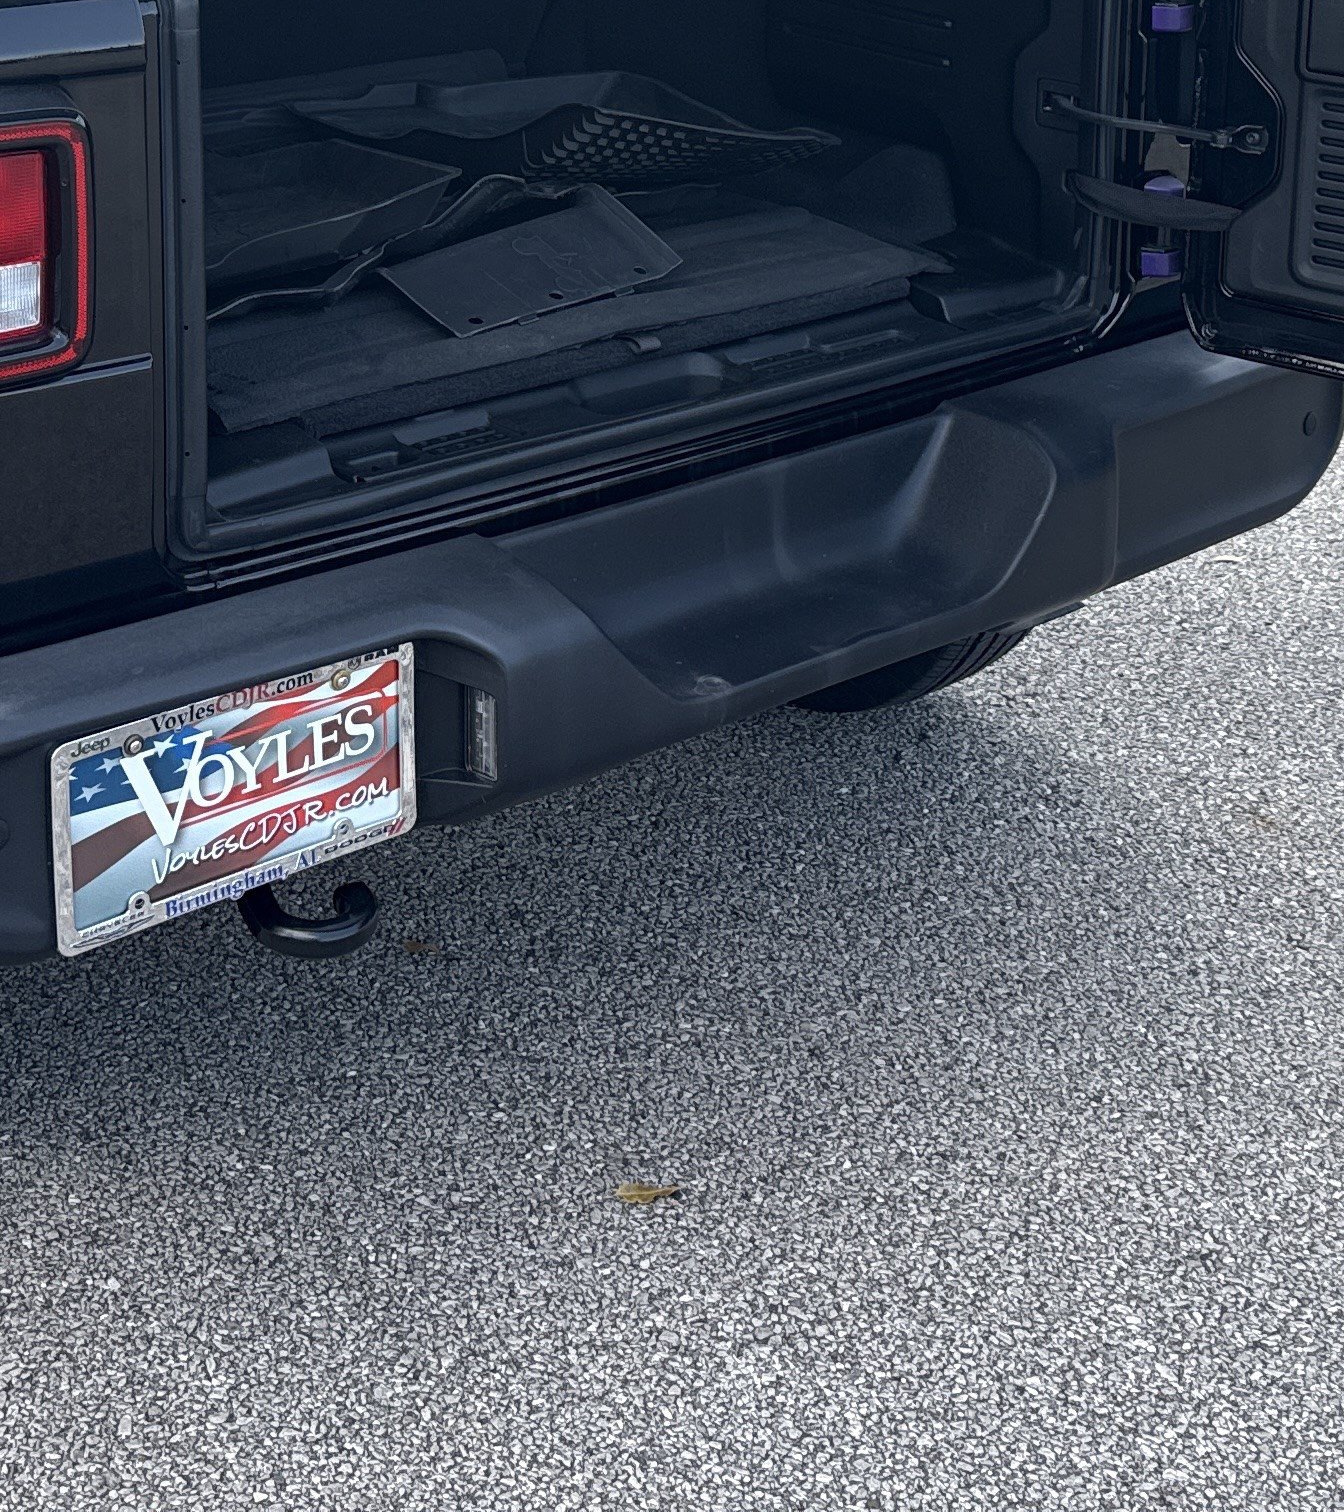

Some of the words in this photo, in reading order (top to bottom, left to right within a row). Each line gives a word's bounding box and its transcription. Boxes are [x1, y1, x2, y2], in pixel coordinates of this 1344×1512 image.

[150, 672, 314, 734] VoylesCDJR.com
[70, 737, 111, 759] Jeep
[119, 704, 376, 848] VOYLES
[164, 864, 290, 920] Birmingham,
